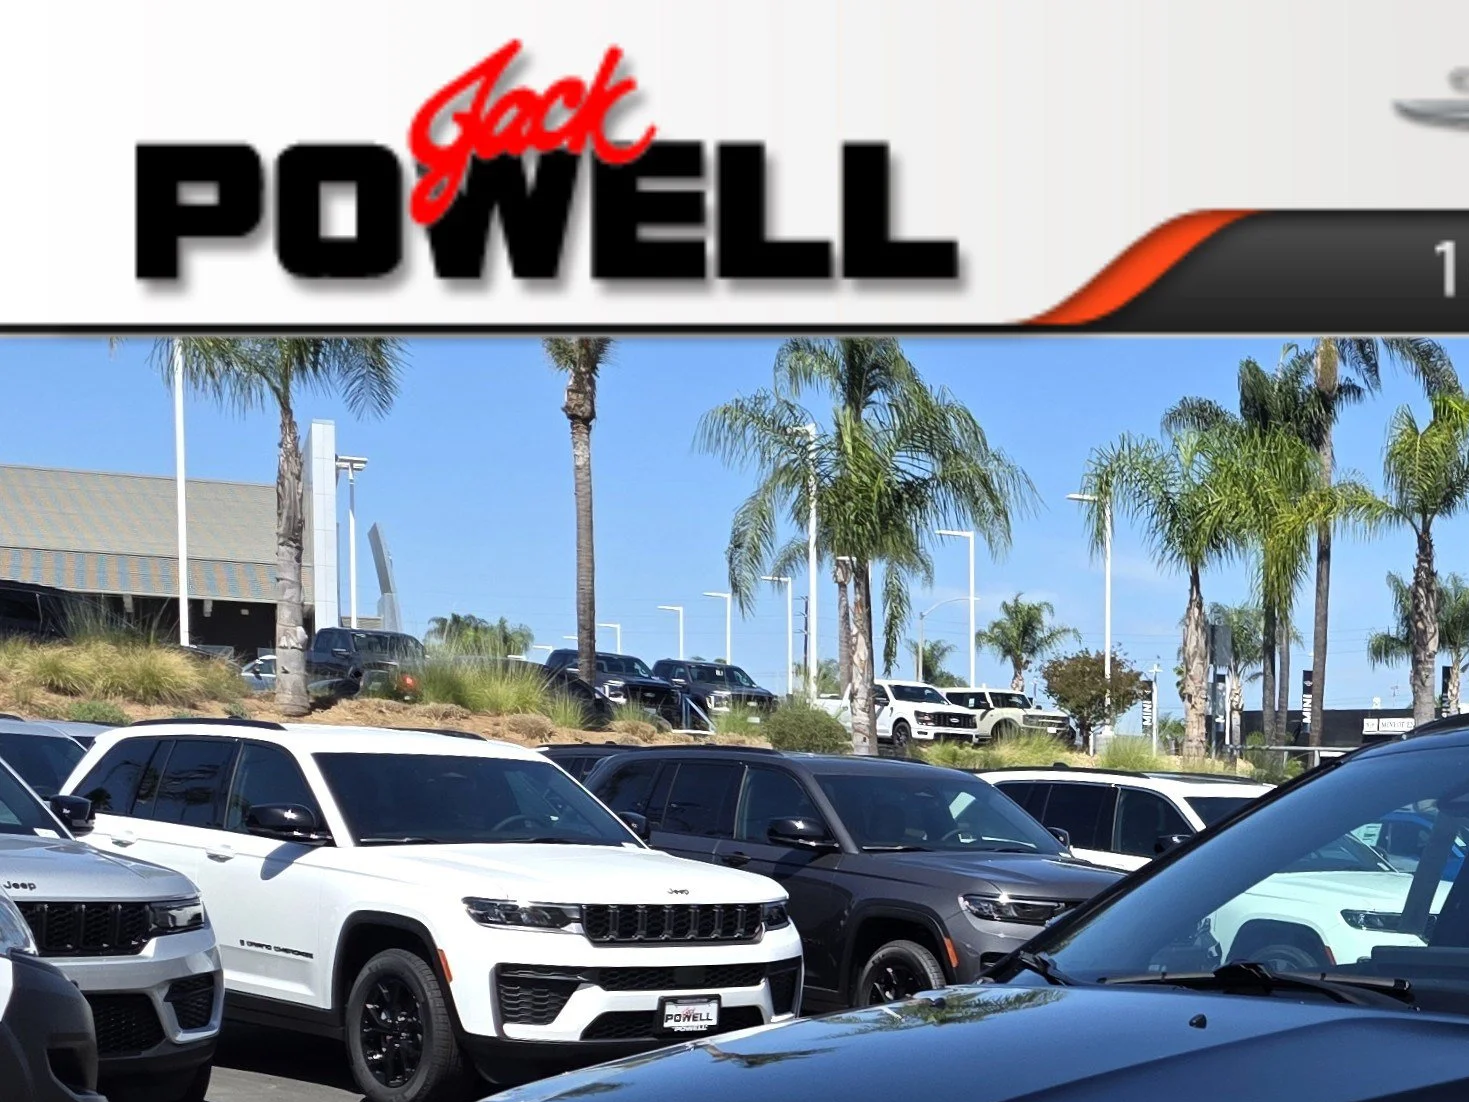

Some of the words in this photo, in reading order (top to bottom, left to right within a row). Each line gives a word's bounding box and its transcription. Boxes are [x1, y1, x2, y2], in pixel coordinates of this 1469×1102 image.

[1142, 700, 1152, 726] MINI
[1302, 693, 1313, 724] MINI
[3, 880, 37, 891] Jeep
[665, 1012, 714, 1023] POWELL
